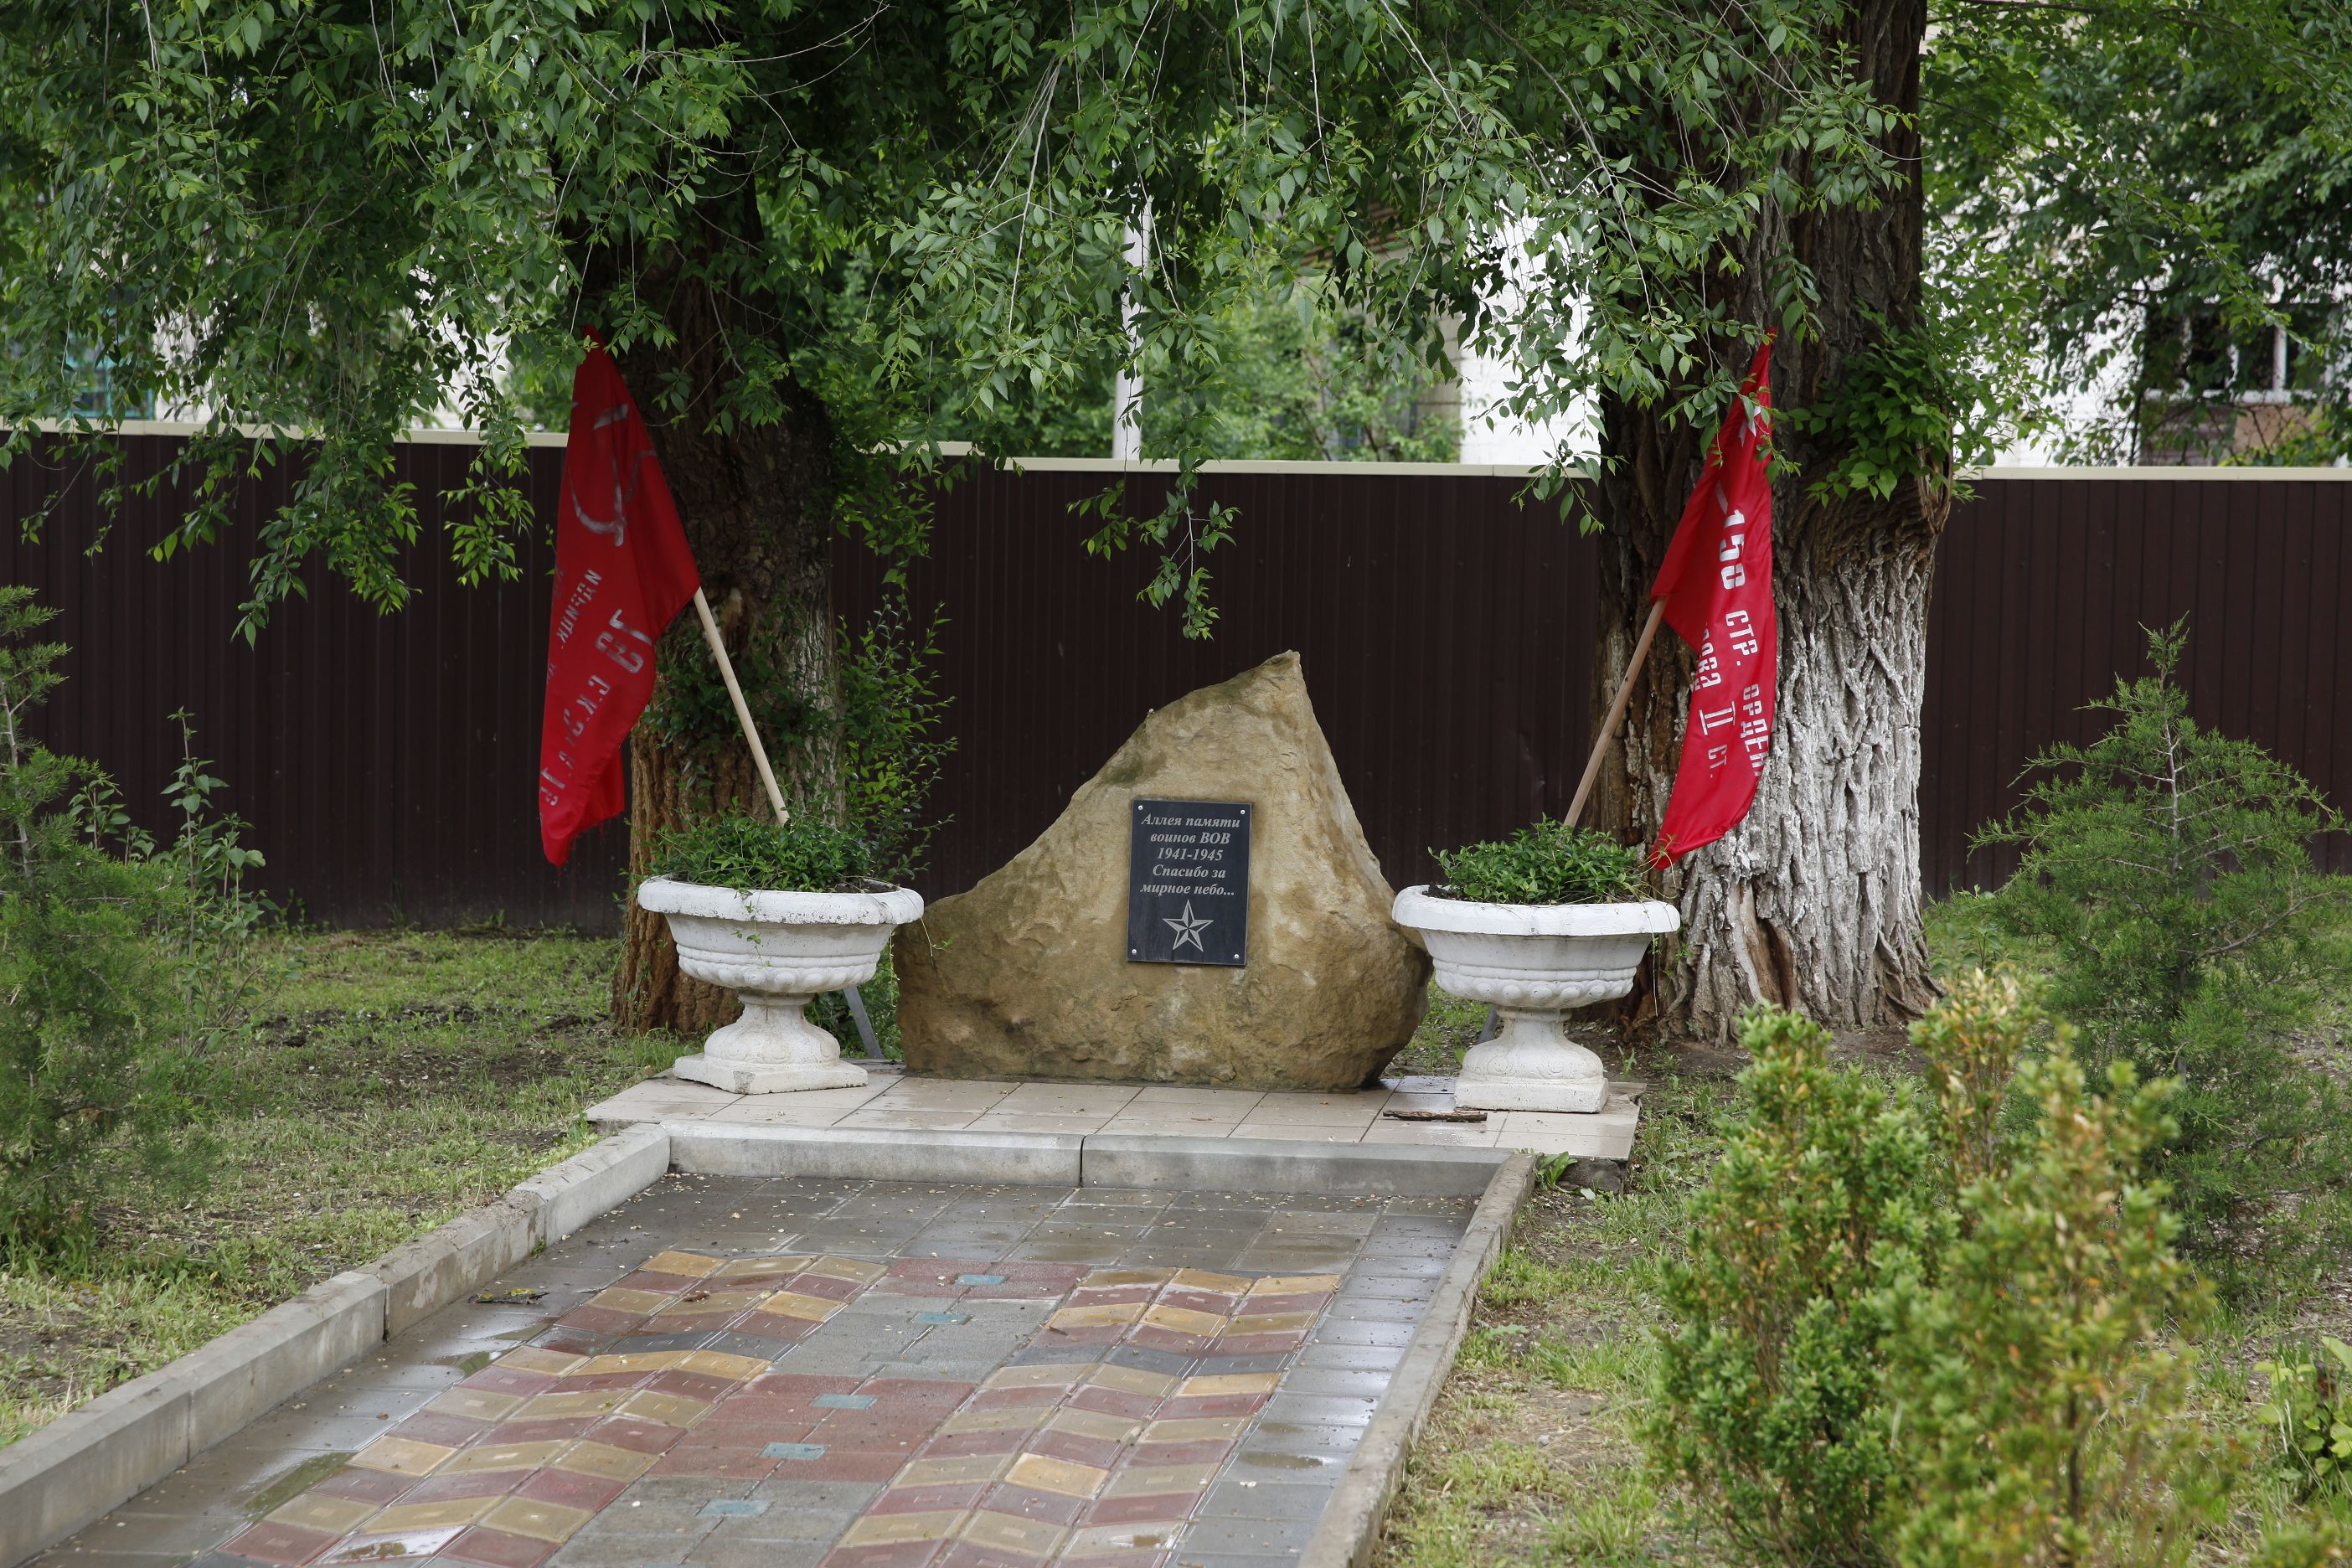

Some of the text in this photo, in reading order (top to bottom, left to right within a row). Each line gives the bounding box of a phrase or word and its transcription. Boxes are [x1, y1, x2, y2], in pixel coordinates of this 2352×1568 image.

[1719, 508, 1746, 591] 150
[1140, 812, 1240, 828] Аллея памяти
[1150, 832, 1230, 844] воинов ВОВ
[1157, 847, 1224, 861] 1941-1945
[1153, 864, 1226, 878] Спасибо за
[1139, 883, 1235, 896] мирное небо...
